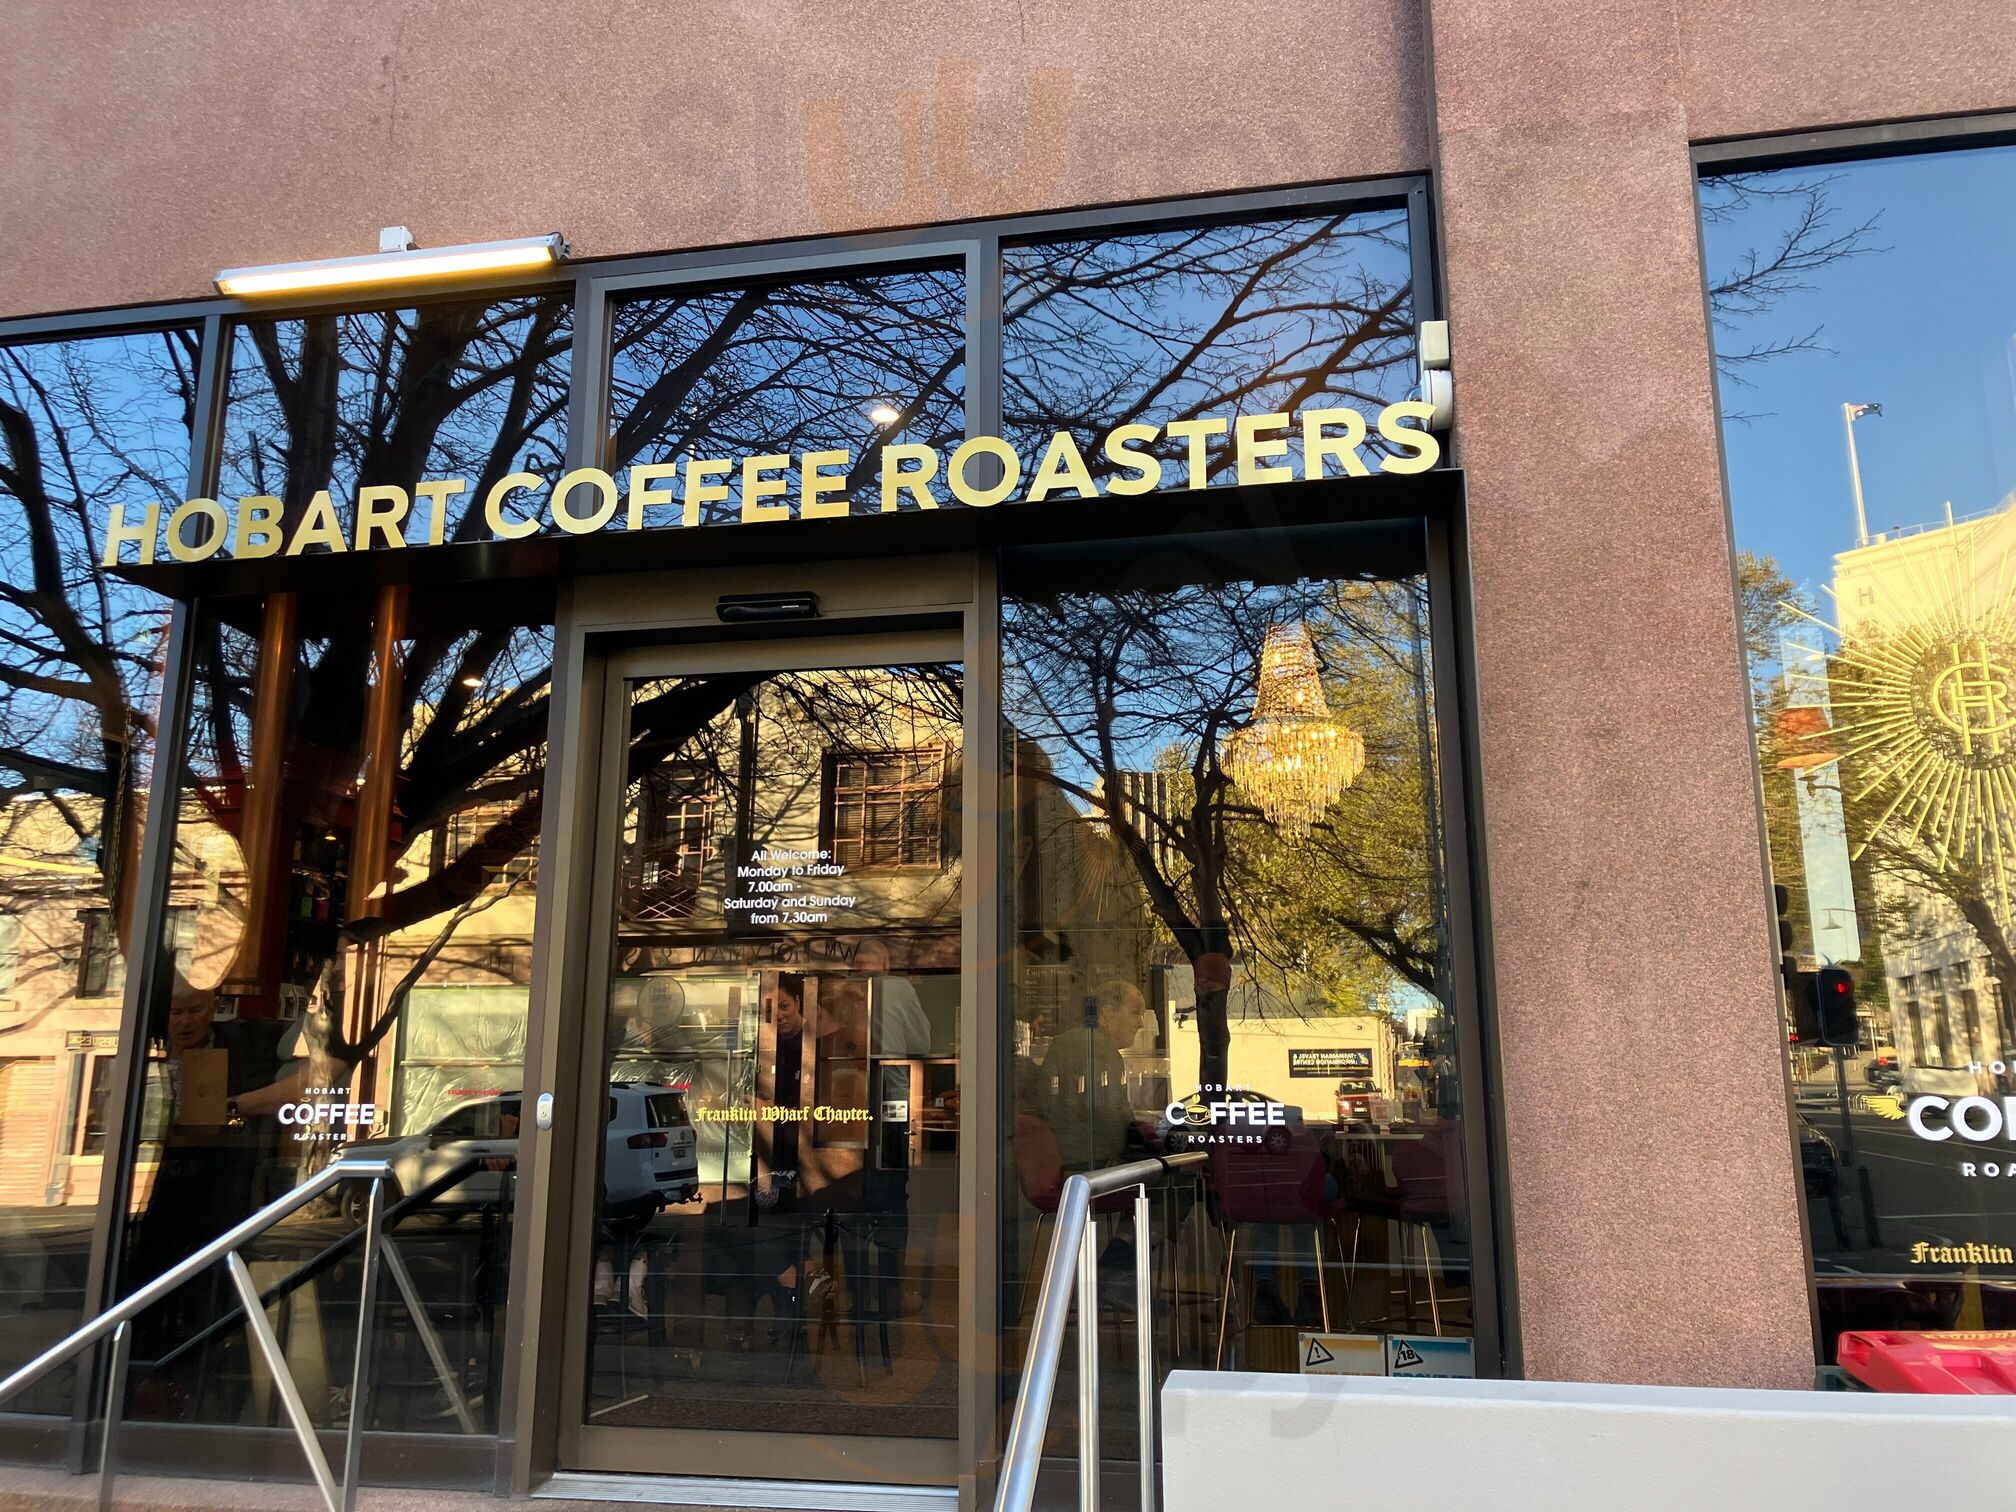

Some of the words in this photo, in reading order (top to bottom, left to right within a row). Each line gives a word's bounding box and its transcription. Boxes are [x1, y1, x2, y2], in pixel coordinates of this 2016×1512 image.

[103, 478, 466, 566] HOBART
[484, 449, 851, 540] COFFEE
[880, 401, 1441, 513] ROASTERS
[750, 850, 767, 861] All
[770, 849, 832, 860] Welcome:
[737, 866, 788, 878] Monday
[792, 866, 804, 876] to
[807, 864, 845, 877] Friday
[748, 881, 793, 892] 7.00am
[724, 898, 778, 910] Saturday
[781, 896, 806, 907] and
[809, 895, 856, 907] Sunday
[750, 912, 779, 924] from
[782, 912, 828, 923] 7.30am
[1968, 1060, 2016, 1075] HO
[305, 1087, 351, 1095] HOBART
[278, 1103, 376, 1125] COFFEE
[695, 1106, 757, 1122] Franklin
[761, 1105, 811, 1124] Wharf
[813, 1105, 874, 1124] Chapter.
[293, 1133, 355, 1141] ROASTERS
[1188, 1135, 1263, 1144] ROASTERS
[1910, 1241, 2015, 1264] Franklin
